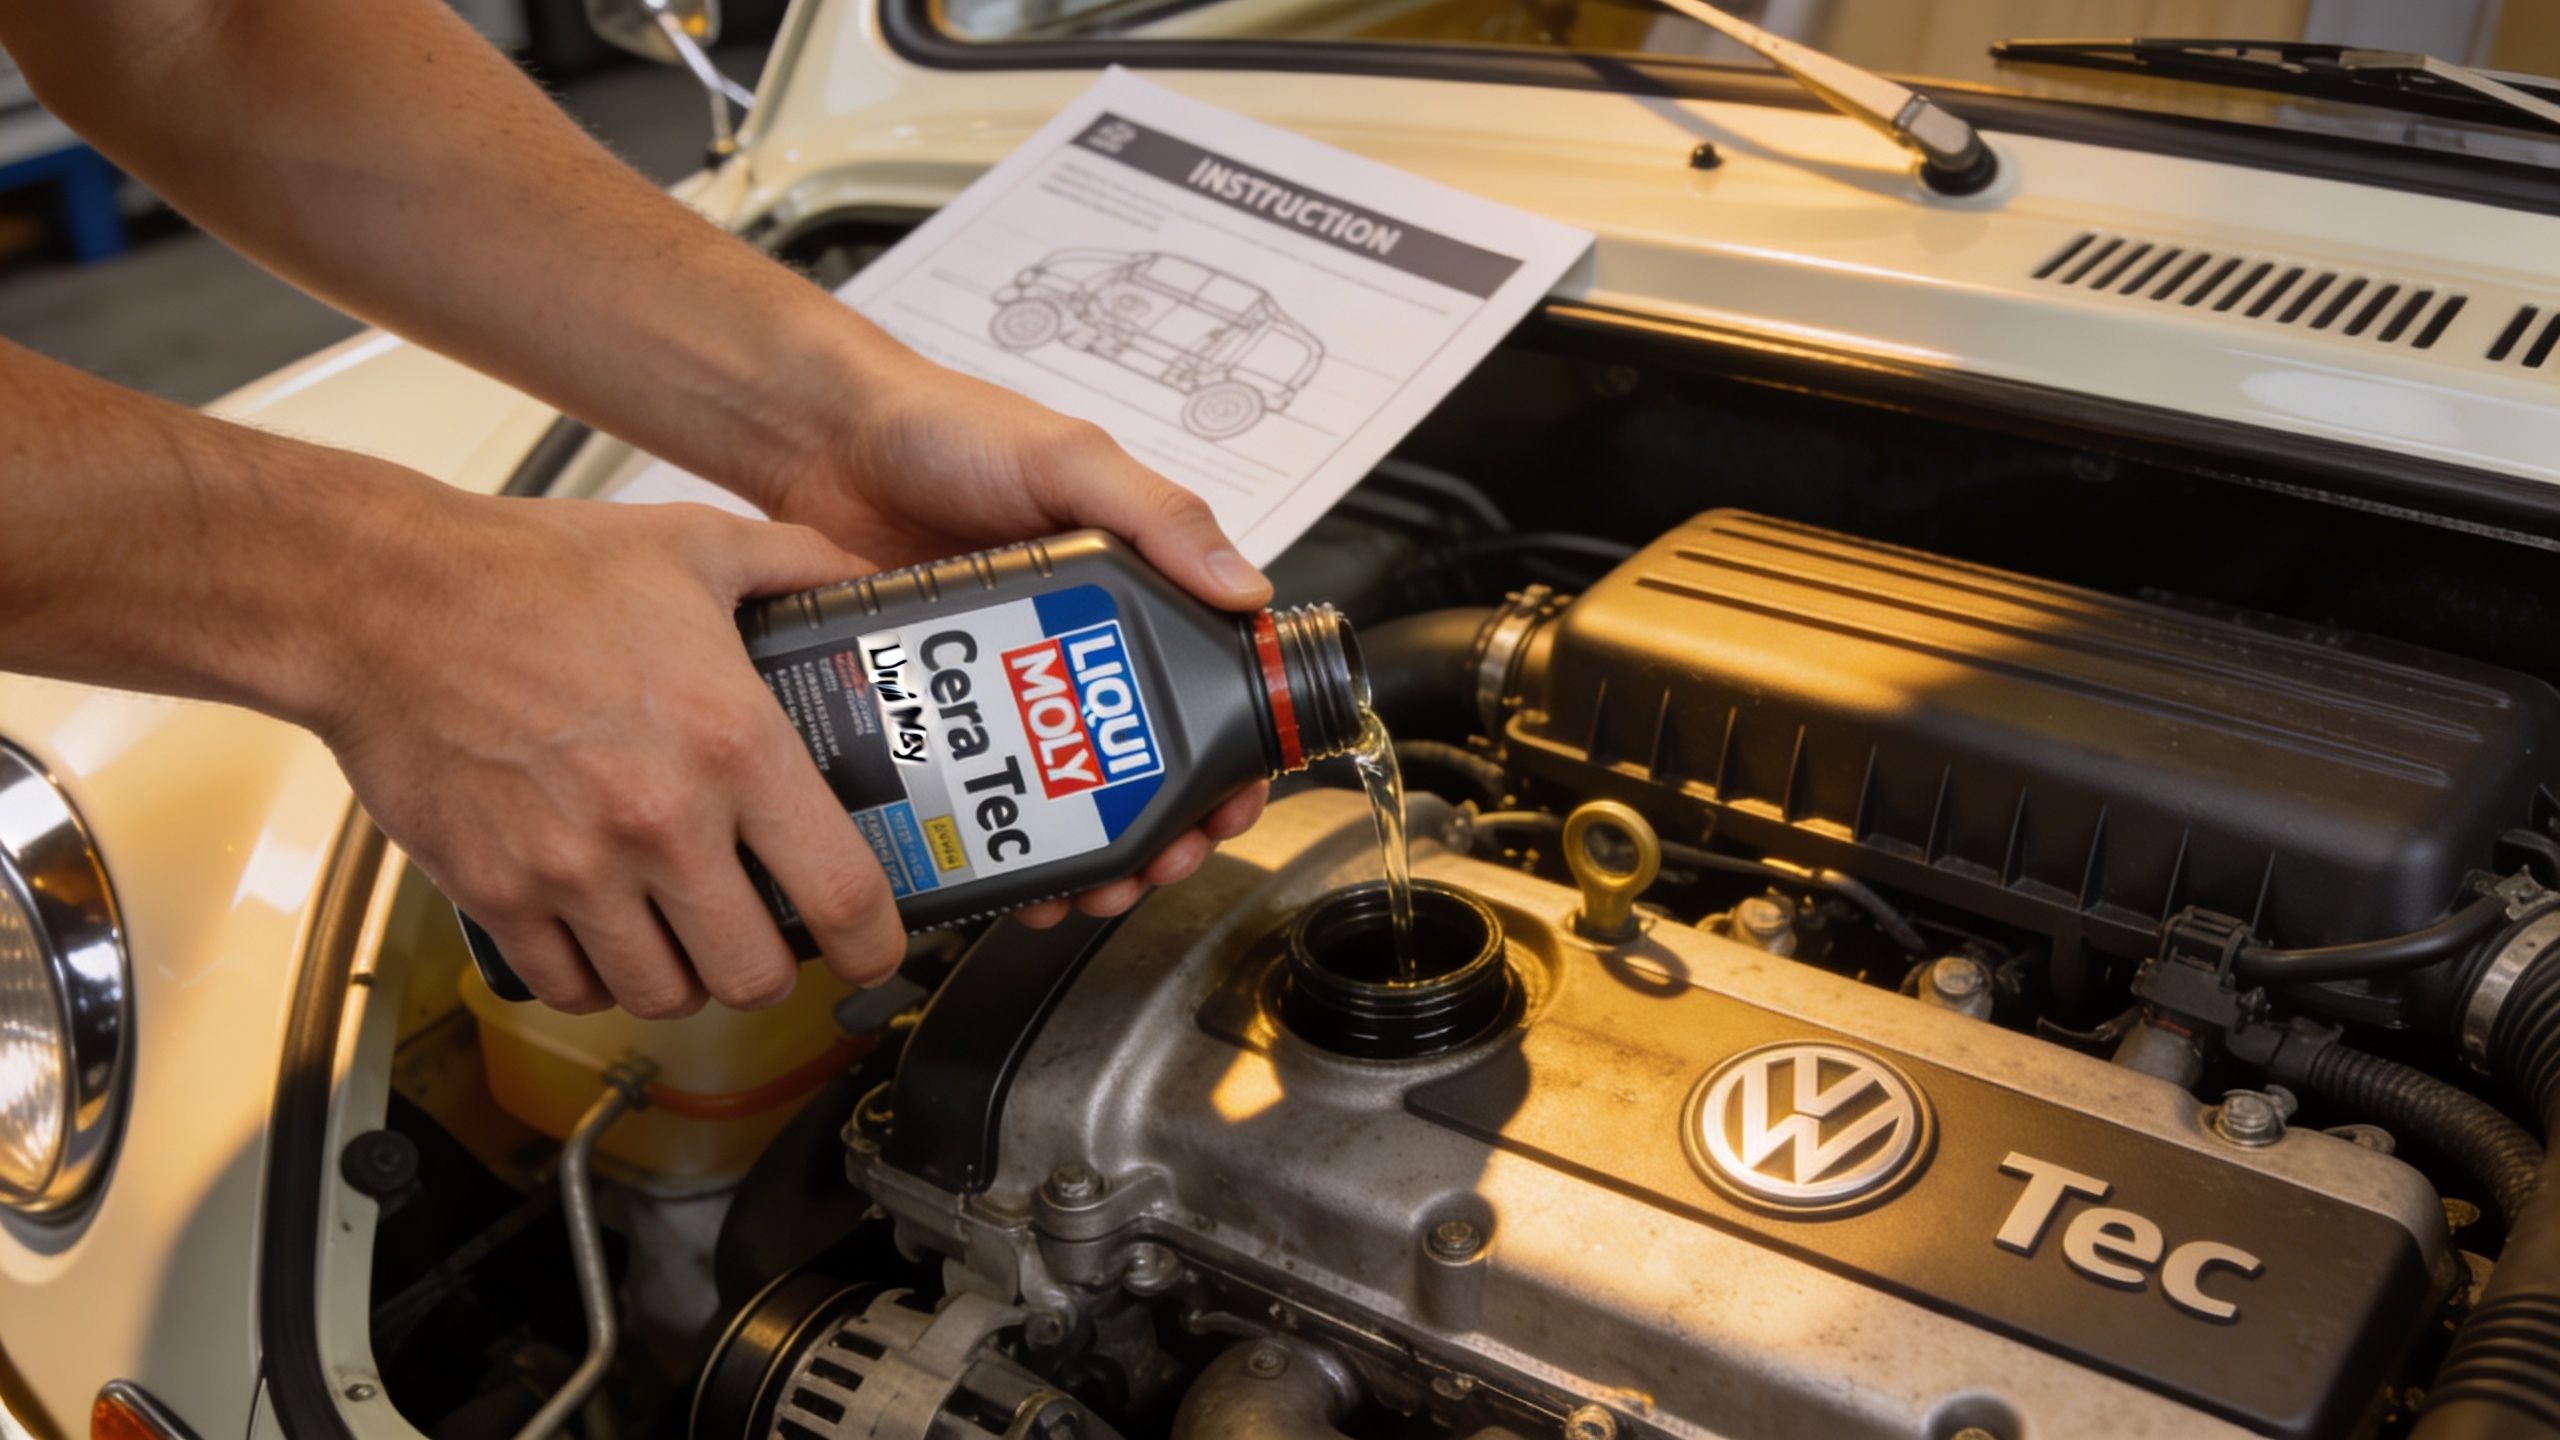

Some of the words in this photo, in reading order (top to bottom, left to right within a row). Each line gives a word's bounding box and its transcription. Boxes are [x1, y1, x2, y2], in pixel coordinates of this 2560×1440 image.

[1187, 157, 1402, 257] INSTRUCTION
[919, 629, 991, 762] Cera
[963, 755, 1032, 864] Tec
[1010, 647, 1098, 790] MOLY
[1067, 632, 1153, 775] LIQUI
[1993, 1150, 2263, 1321] Tec
